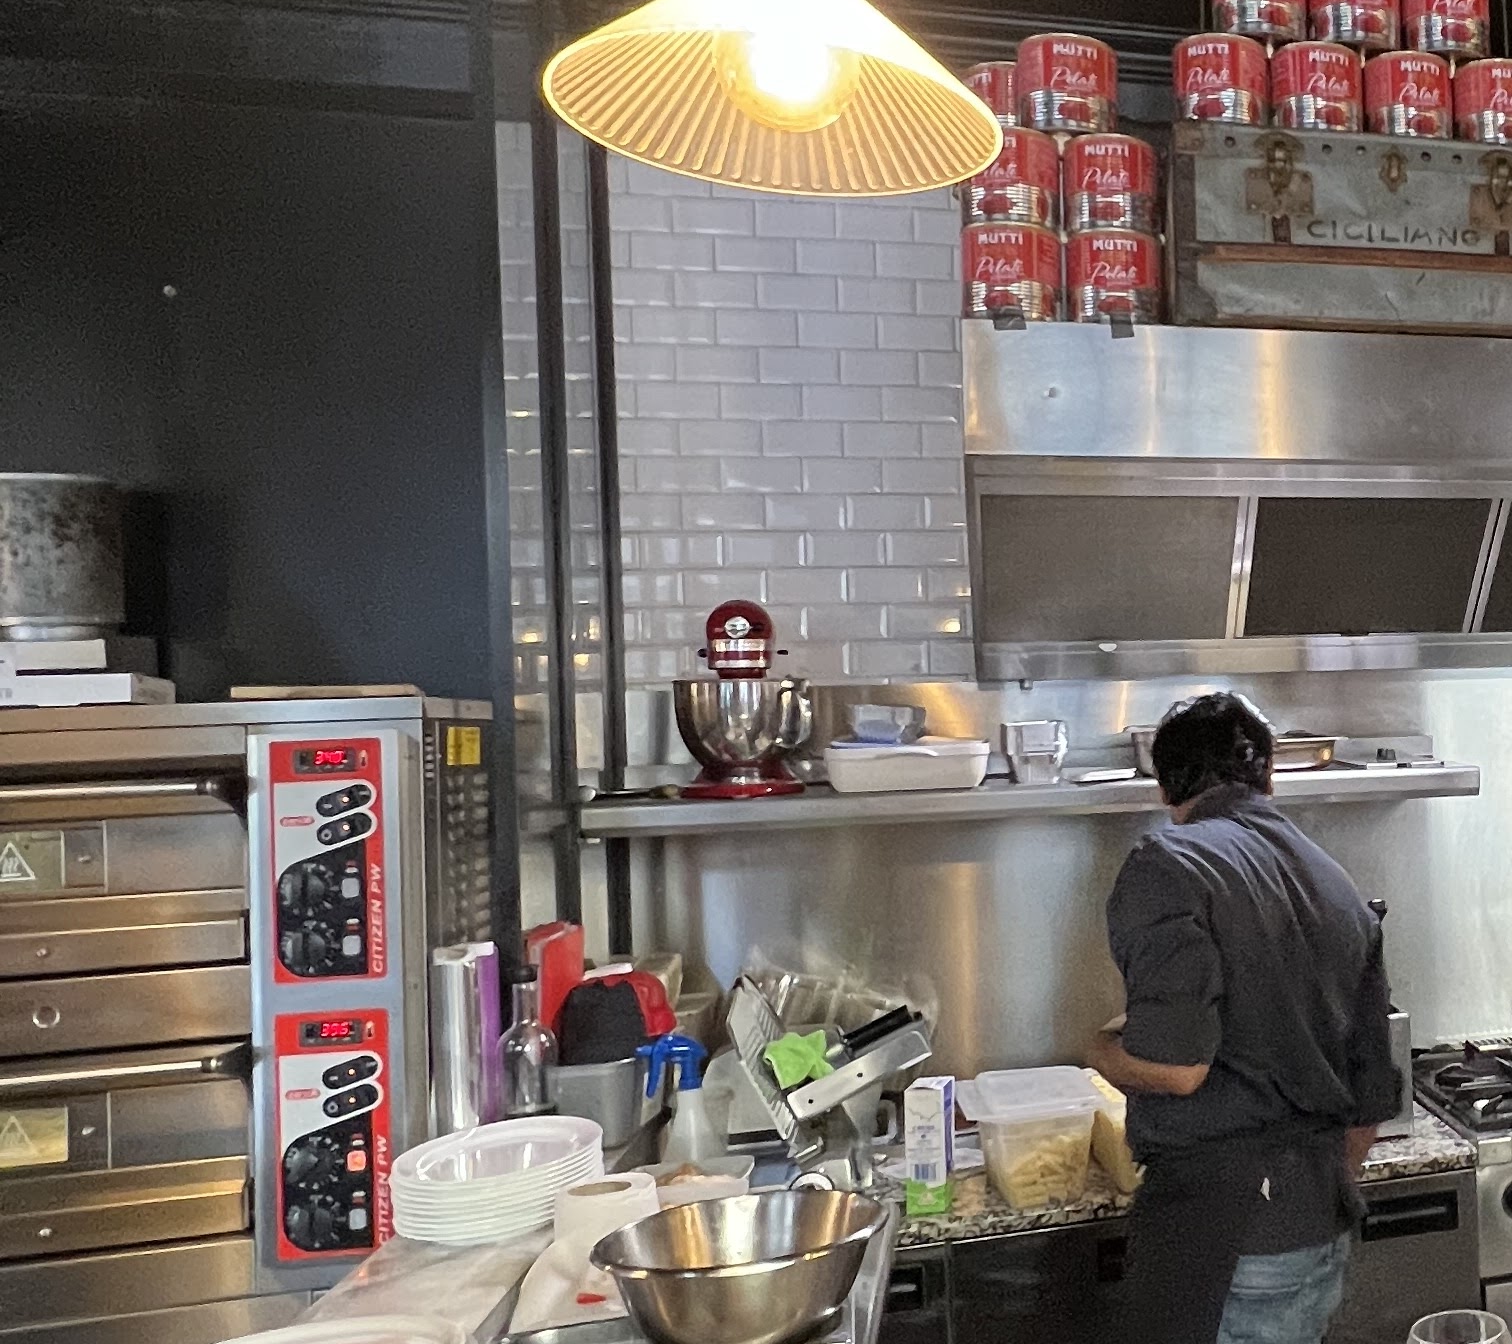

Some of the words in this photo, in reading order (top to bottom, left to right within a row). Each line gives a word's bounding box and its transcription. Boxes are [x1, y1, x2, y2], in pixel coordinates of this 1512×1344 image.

[1053, 42, 1097, 60] MUTTI
[1187, 43, 1229, 57] MUTTI
[1308, 49, 1349, 66] MUTTI
[1400, 60, 1440, 76] MUTTI
[1084, 143, 1129, 157] MUTTI
[978, 233, 1023, 245] MUTTI
[1093, 239, 1137, 252] MUTTI
[370, 863, 382, 894] PW
[370, 899, 384, 973] CITIZEN
[376, 1135, 388, 1165] PW
[376, 1171, 390, 1243] CITIZEN
